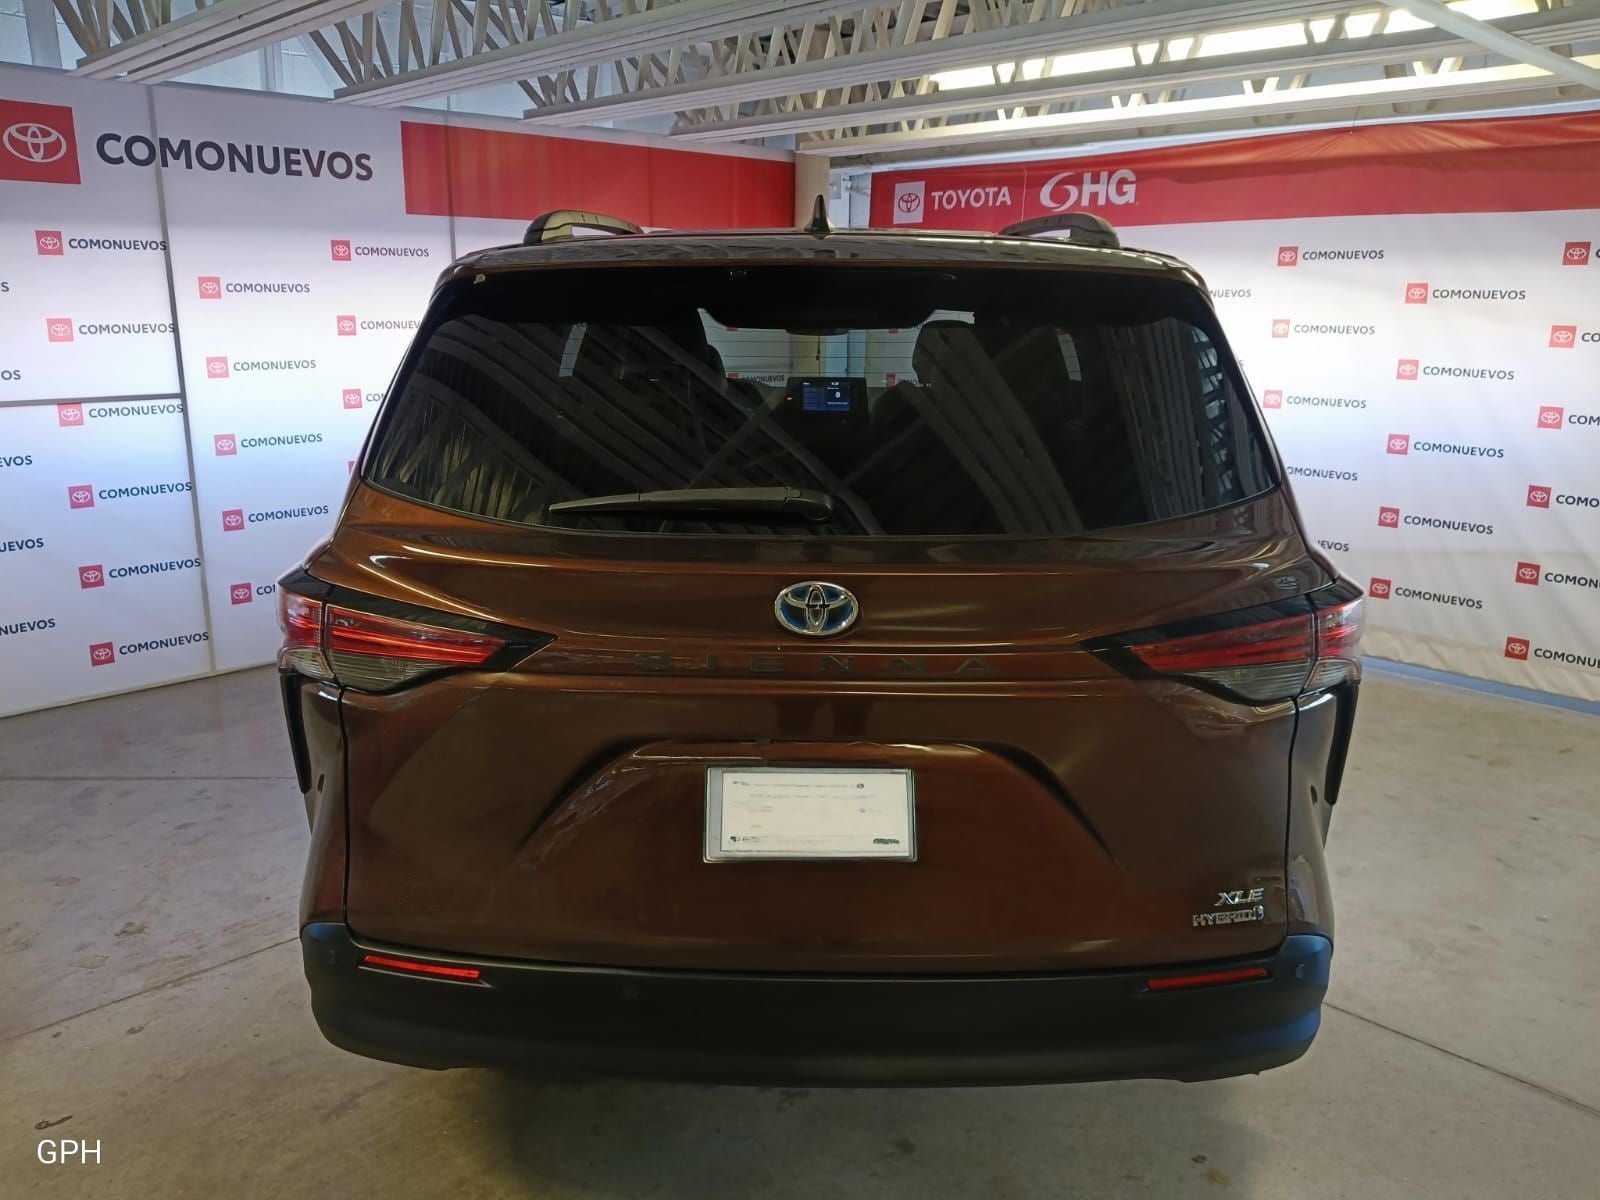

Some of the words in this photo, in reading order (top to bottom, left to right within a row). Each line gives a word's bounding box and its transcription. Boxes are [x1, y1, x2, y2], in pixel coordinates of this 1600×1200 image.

[96, 132, 373, 181] COMONUEVOS
[931, 186, 1012, 210] TOYOTA
[68, 238, 167, 251] COMONUEVOS
[355, 246, 430, 258] COMONUEVOS
[1302, 249, 1385, 261] COMONUEVOS
[225, 283, 311, 294] COMONUEVOS
[1432, 289, 1526, 300] COMONUEVOS
[79, 323, 175, 335] COMONUEVOS
[1294, 324, 1376, 335] COMONUEVOS
[233, 359, 317, 372] COMONUEVOS
[1423, 366, 1515, 381] COMONUEVOS
[1286, 395, 1367, 409] COMONUEVOS
[88, 403, 184, 418] COMONUEVOS
[240, 433, 323, 448] COMONUEVOS
[1413, 441, 1504, 458] COMONUEVOS
[98, 481, 193, 500] COMONUEVOS
[248, 505, 329, 523] COMONUEVOS
[1403, 515, 1494, 535] COMONUEVOS
[1317, 540, 1349, 552] EVOS
[108, 558, 202, 578] COMONUEVOS
[1544, 572, 1600, 589] COMON
[1395, 586, 1483, 609] COMONUEVOS
[118, 631, 210, 656] COMONUEVOS
[634, 653, 998, 672] SIENNA
[1213, 887, 1265, 907] XLE
[1192, 909, 1255, 927] HYBRID
